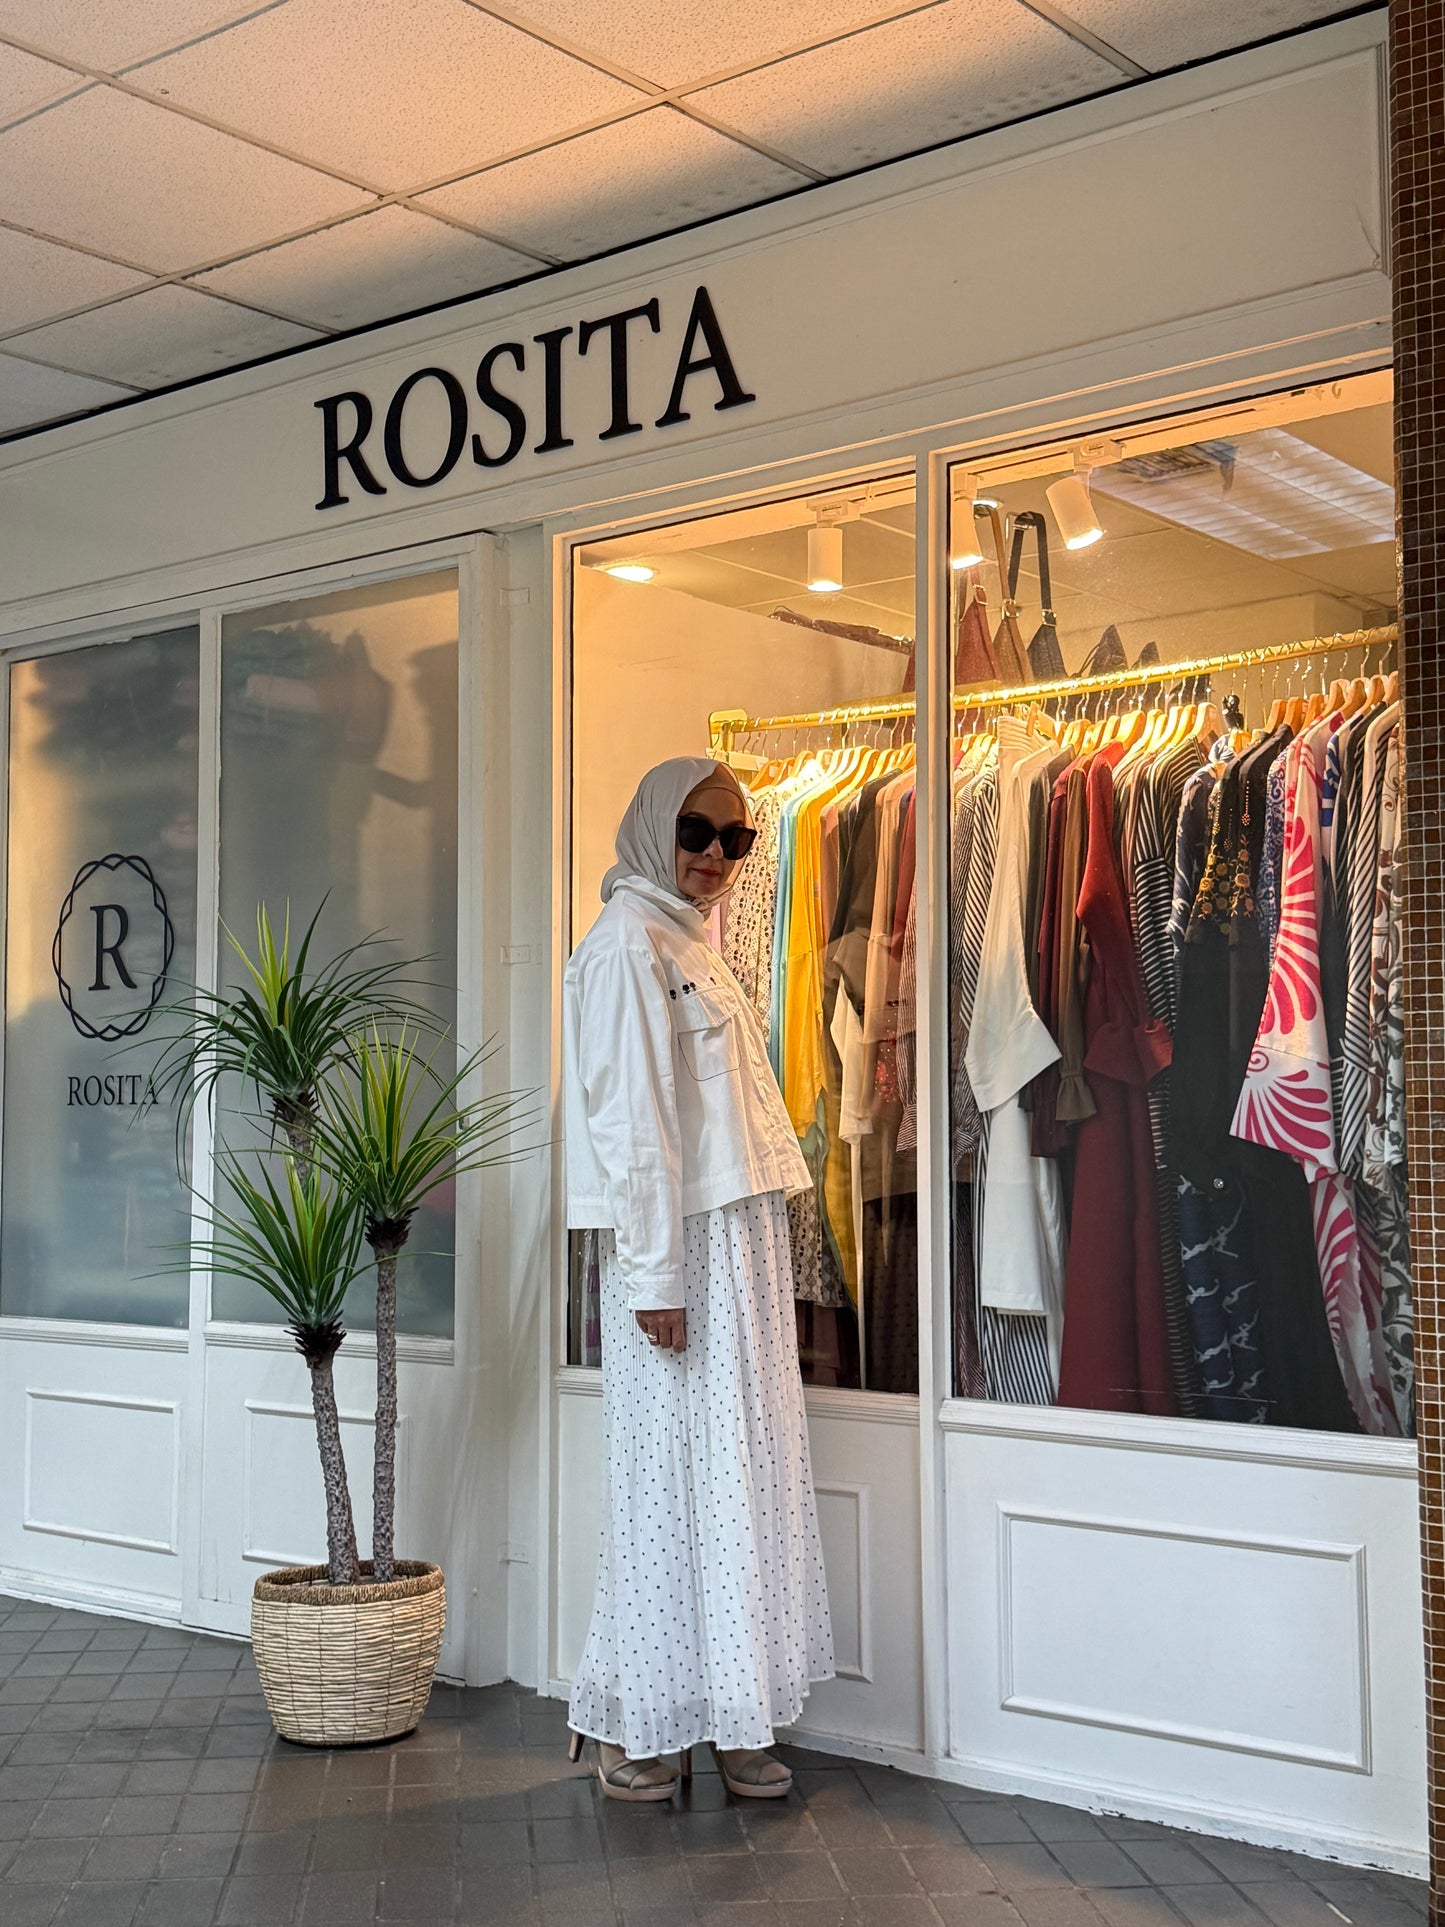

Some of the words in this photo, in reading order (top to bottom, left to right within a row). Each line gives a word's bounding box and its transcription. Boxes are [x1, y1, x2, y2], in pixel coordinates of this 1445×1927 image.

[313, 285, 757, 511] ROSITA
[88, 904, 138, 992] R
[67, 1074, 159, 1106] ROSITA
